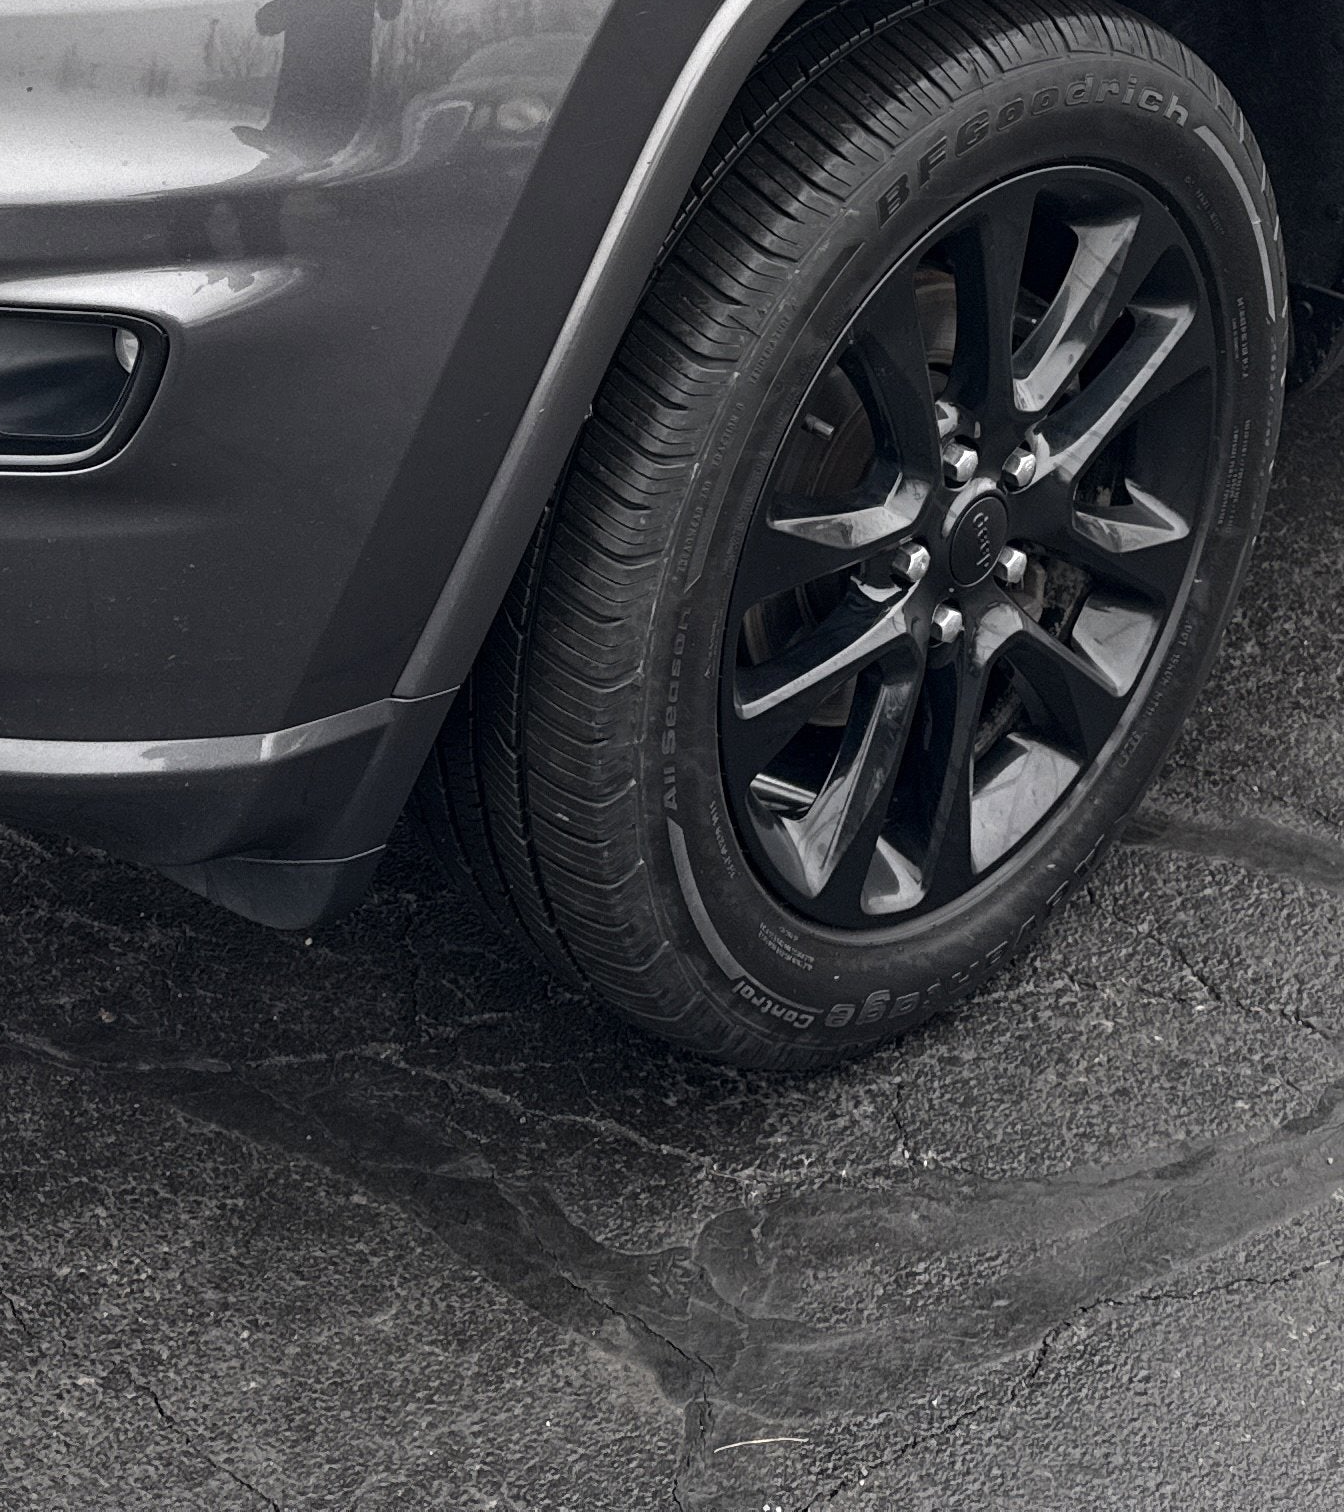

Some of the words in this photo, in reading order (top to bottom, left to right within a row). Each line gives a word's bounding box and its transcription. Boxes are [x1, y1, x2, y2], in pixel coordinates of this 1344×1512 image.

[875, 72, 1190, 229] BFGoodrich
[972, 511, 992, 568] Jeep
[663, 605, 693, 754] Season
[665, 764, 682, 813] All
[730, 978, 816, 1030] Control
